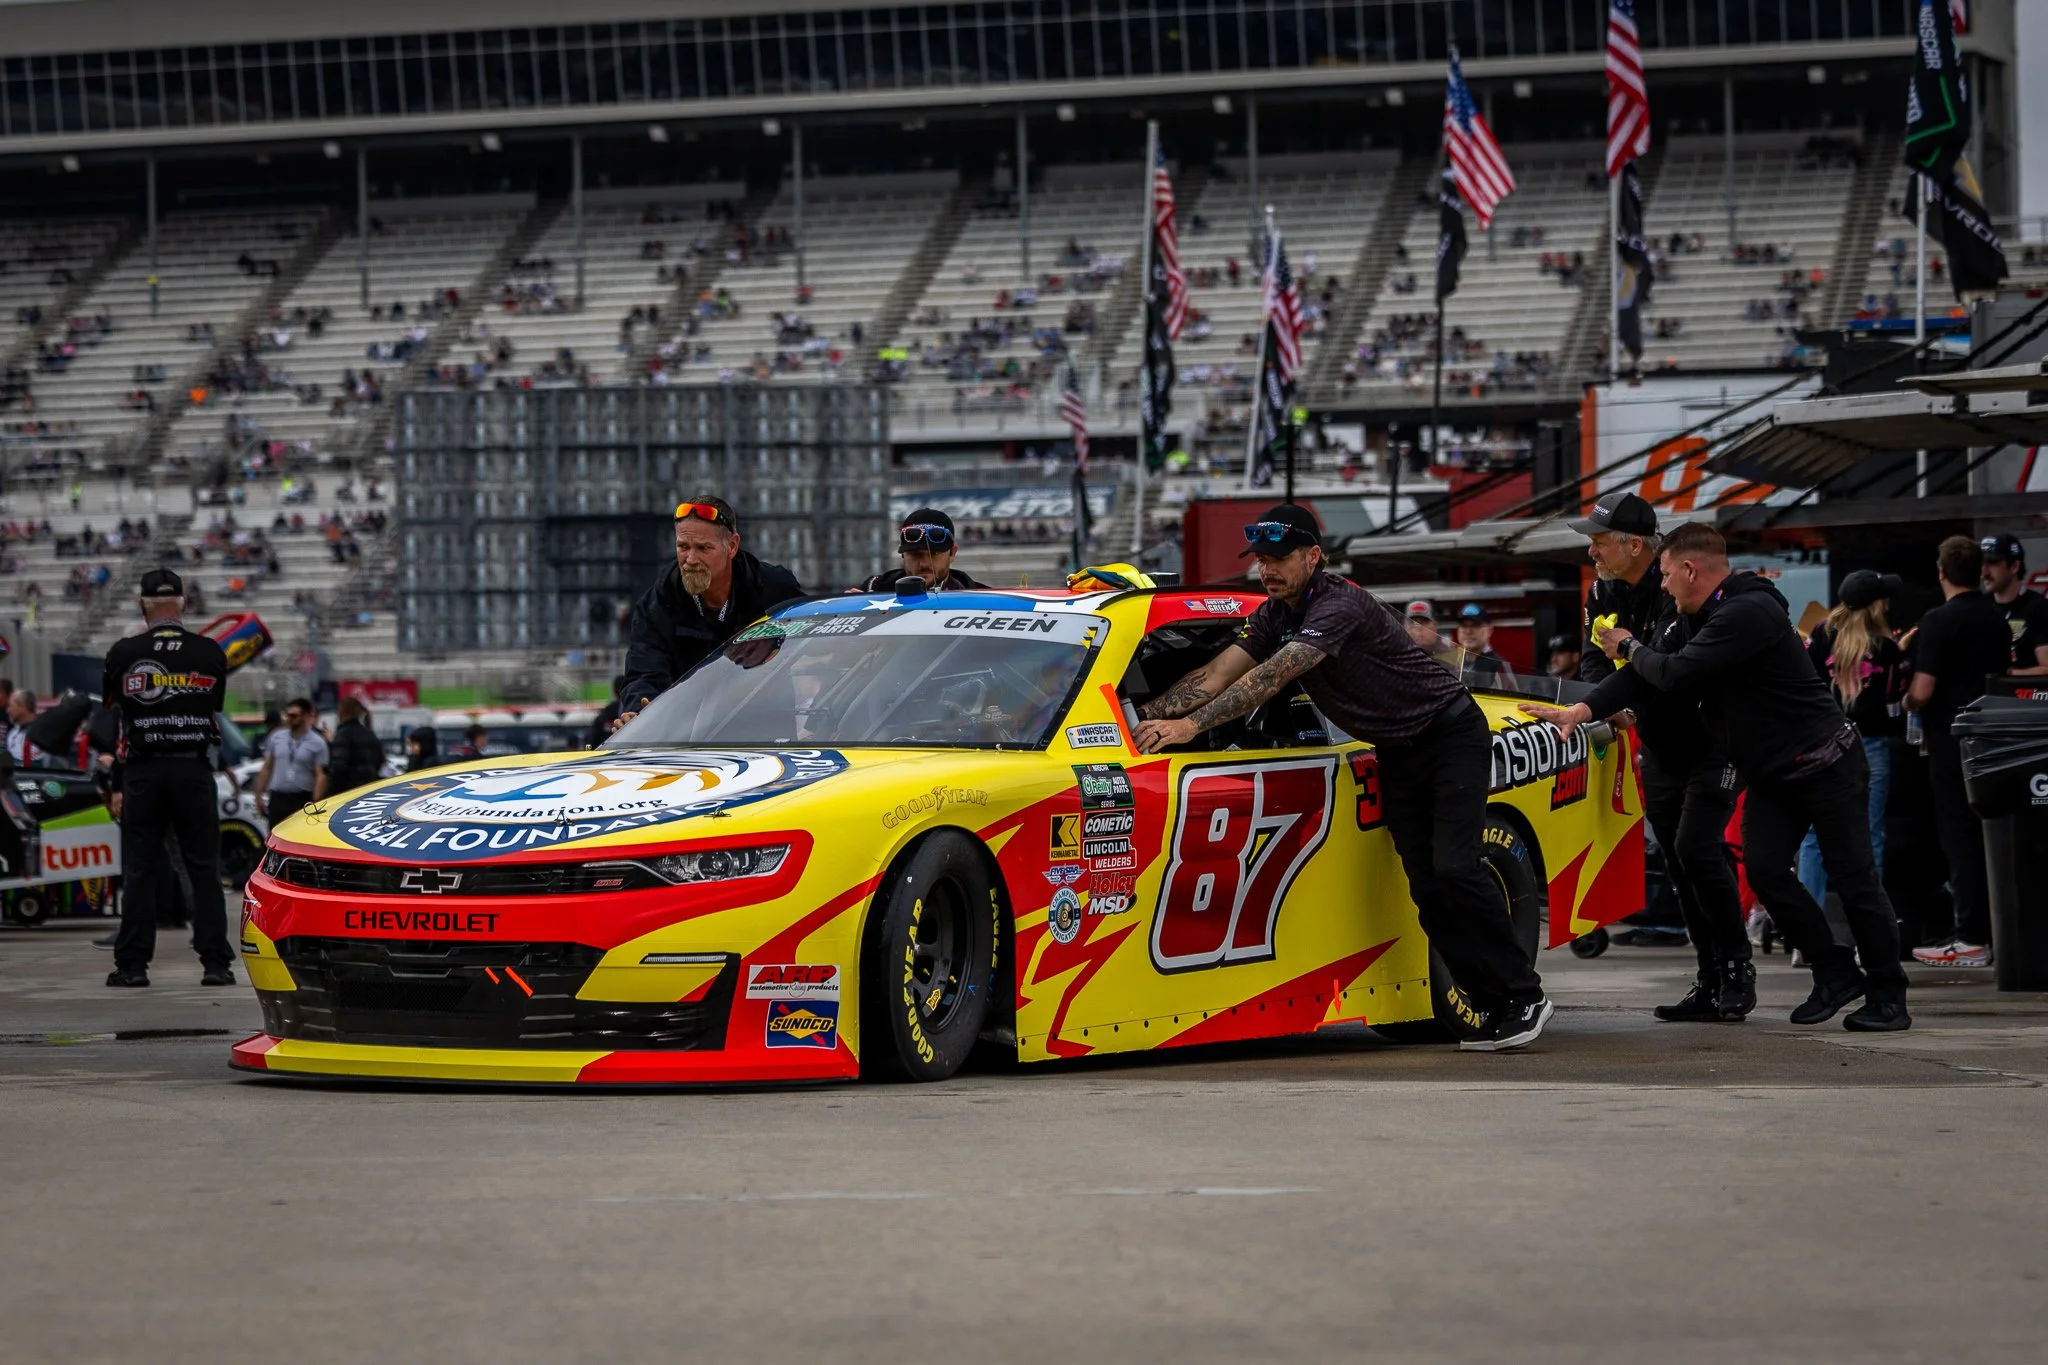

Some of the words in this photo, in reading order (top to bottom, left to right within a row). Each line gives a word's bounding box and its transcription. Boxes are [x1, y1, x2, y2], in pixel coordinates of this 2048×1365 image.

[809, 624, 860, 634] PARTS
[824, 616, 866, 626] AUTO
[943, 616, 1058, 633] GREEN
[1077, 726, 1114, 737] NASCAR
[1077, 736, 1099, 745] RACE
[1100, 735, 1116, 743] CAR
[1082, 774, 1113, 797] O'Reilly
[1113, 785, 1130, 793] PARTS
[343, 793, 411, 823] NAVY
[881, 785, 989, 830] GOODYEAR
[1100, 800, 1116, 808] SERIES
[1084, 815, 1133, 833] COMETIC
[348, 820, 421, 849] SEAL
[1050, 849, 1079, 858] KENNAMETAL
[1085, 841, 1128, 856] LINCOLN
[1095, 856, 1132, 869] WELDERS
[1149, 754, 1339, 974] 87
[1089, 872, 1137, 898] Holley
[1052, 889, 1078, 908] CHAMPION
[1087, 895, 1130, 915] MSD
[344, 910, 500, 933] CHEVROLET
[1051, 920, 1078, 941] IRRIGATION
[750, 965, 837, 984] ARP
[903, 898, 934, 1064] GOODYEAR
[748, 984, 789, 992] automotive
[771, 1018, 832, 1031] SUNOCO
